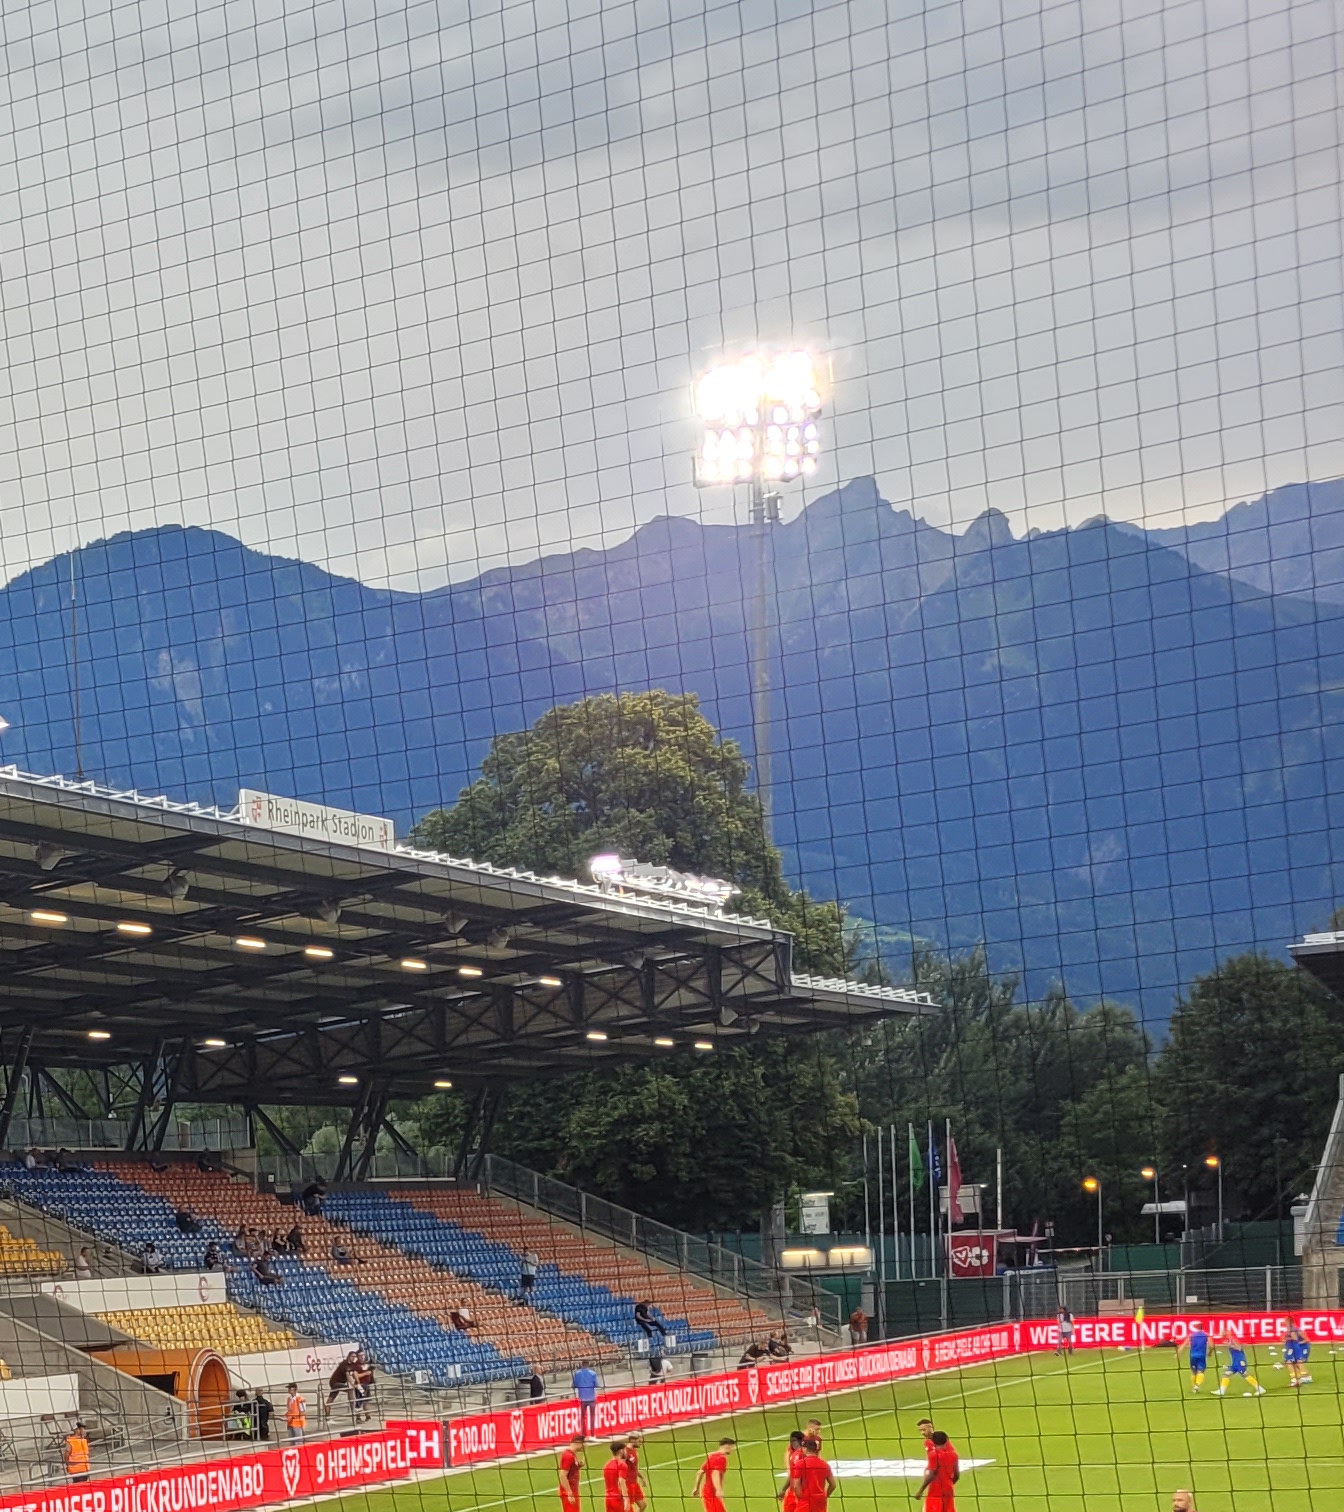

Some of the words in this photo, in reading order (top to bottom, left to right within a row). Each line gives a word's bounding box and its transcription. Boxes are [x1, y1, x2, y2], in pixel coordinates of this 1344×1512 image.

[267, 799, 327, 832] Rheinpark
[332, 813, 375, 842] Stadion
[1029, 1322, 1126, 1346] WETERE
[306, 1354, 322, 1373] See
[618, 1393, 650, 1425] UNTER
[459, 1422, 497, 1454] 100.00
[316, 1453, 325, 1484] 9
